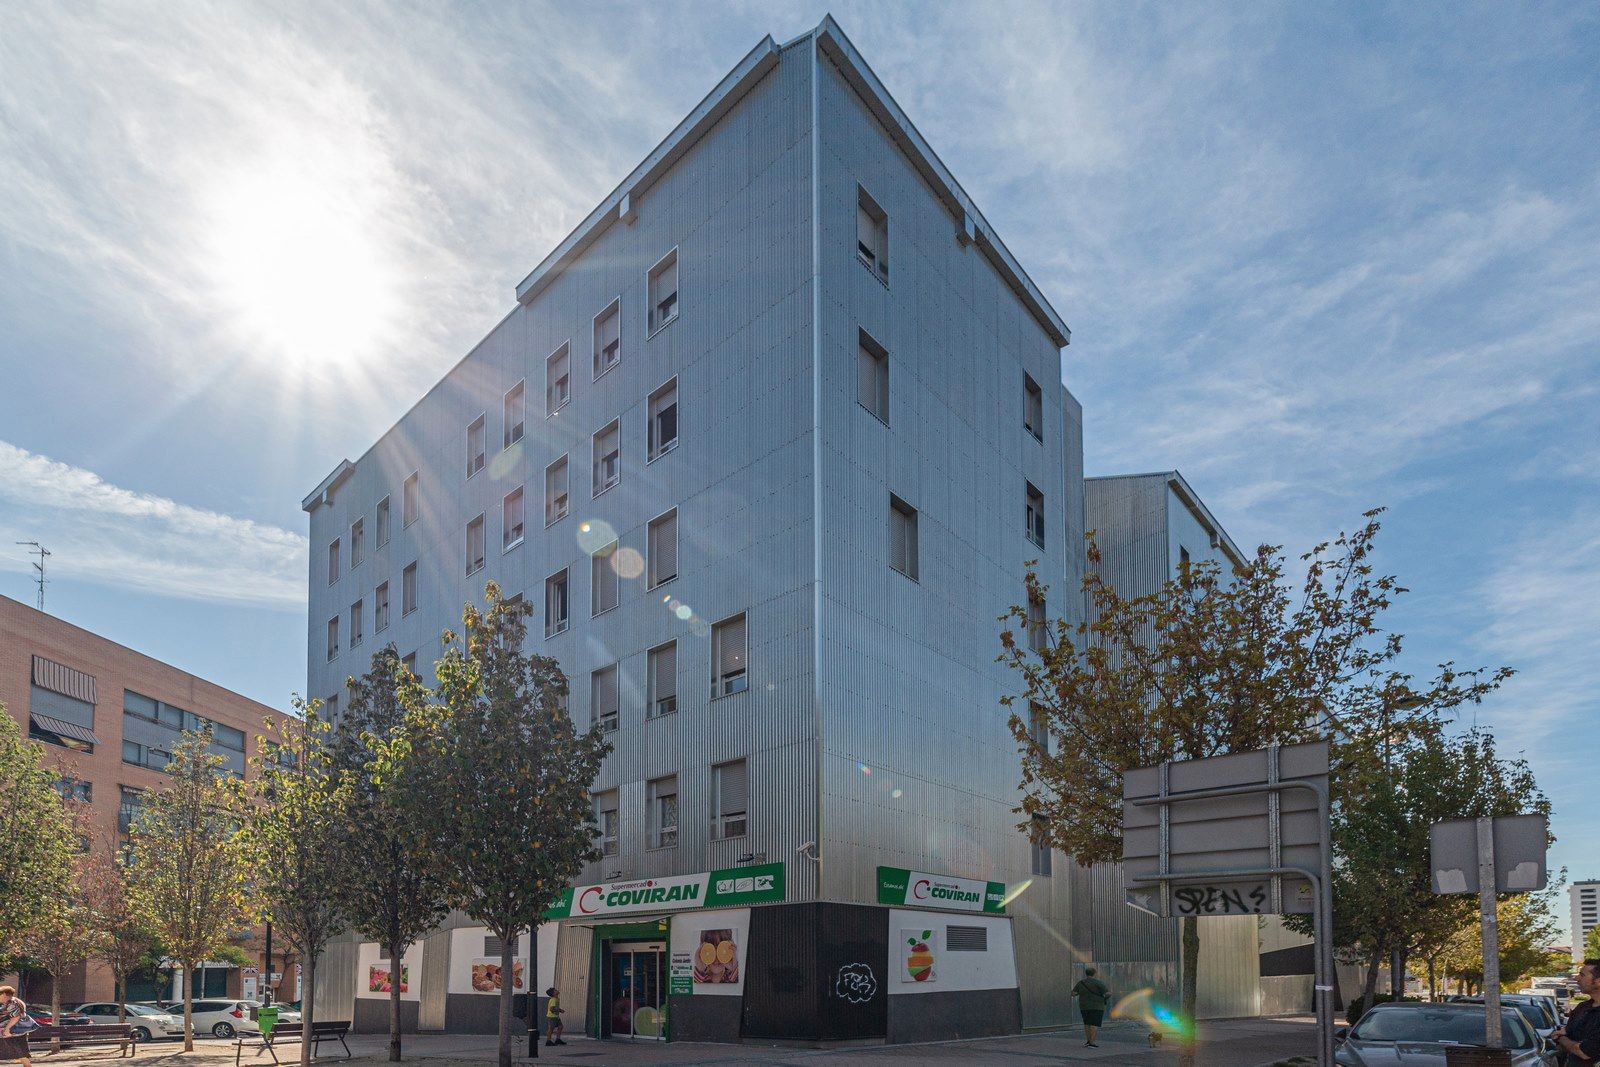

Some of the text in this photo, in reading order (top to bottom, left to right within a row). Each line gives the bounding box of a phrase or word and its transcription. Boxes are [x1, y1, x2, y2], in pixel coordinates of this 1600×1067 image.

[610, 880, 658, 891] Supermercados
[606, 884, 700, 907] COVIRAN
[931, 887, 980, 902] COVIRAN
